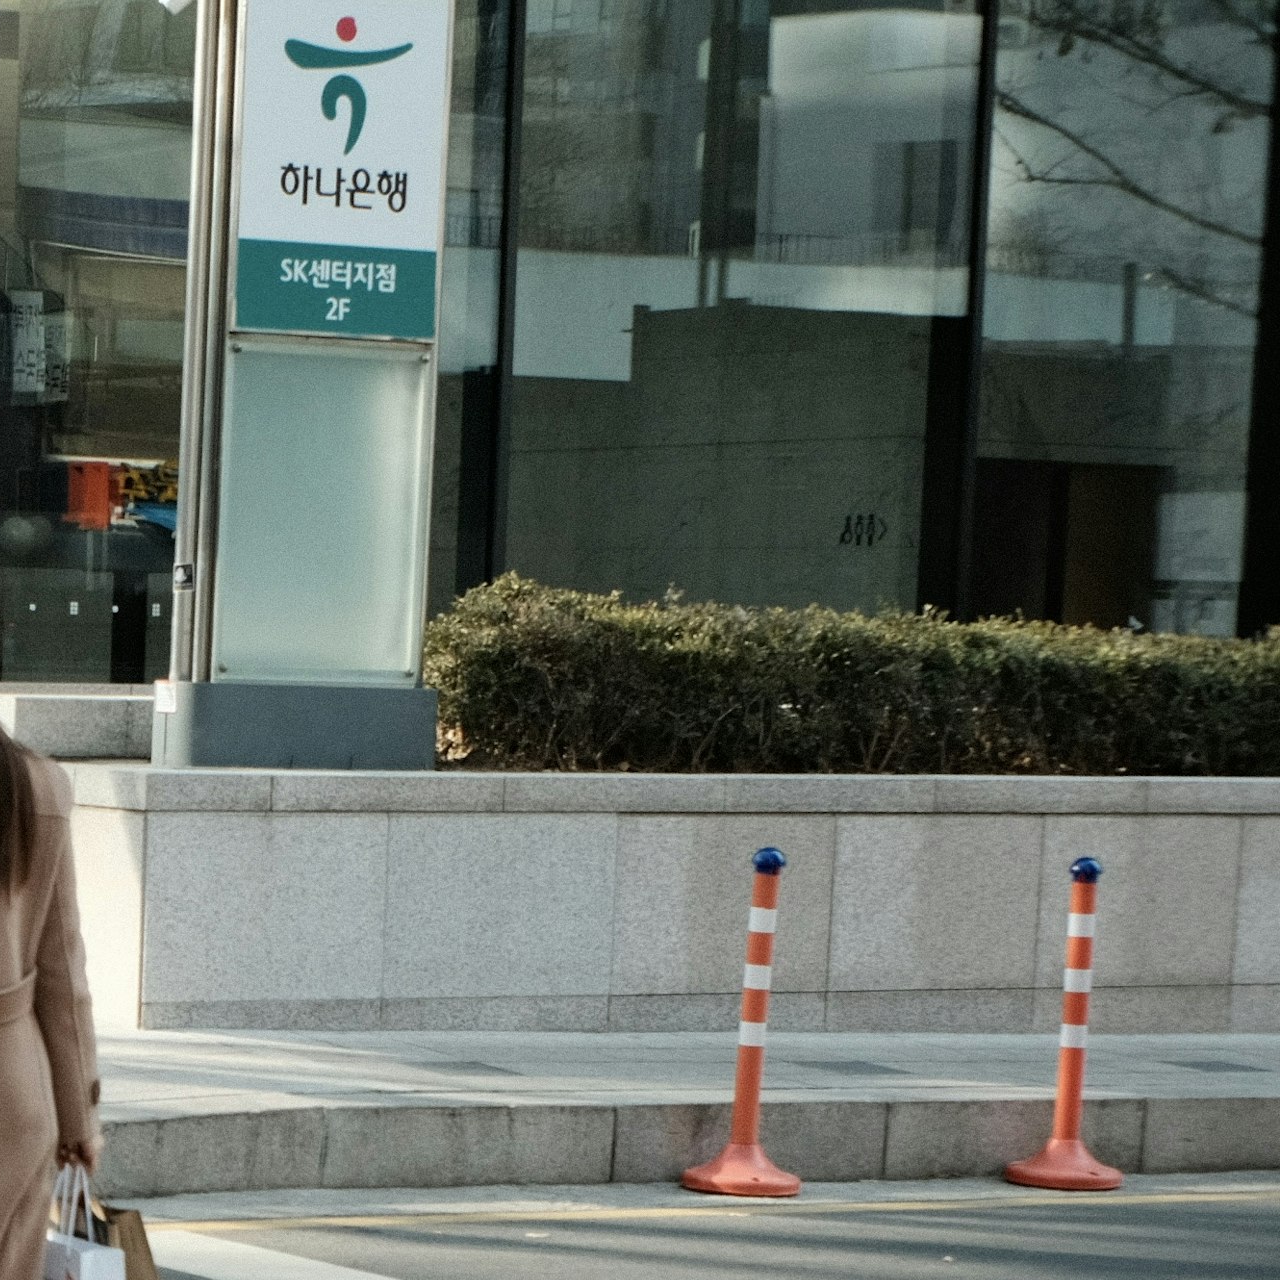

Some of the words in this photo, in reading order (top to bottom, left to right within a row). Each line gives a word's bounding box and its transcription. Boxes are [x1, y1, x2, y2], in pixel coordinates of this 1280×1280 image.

[280, 163, 409, 213] 하나은행
[280, 258, 397, 293] SK센터지점
[325, 297, 351, 322] 2F
